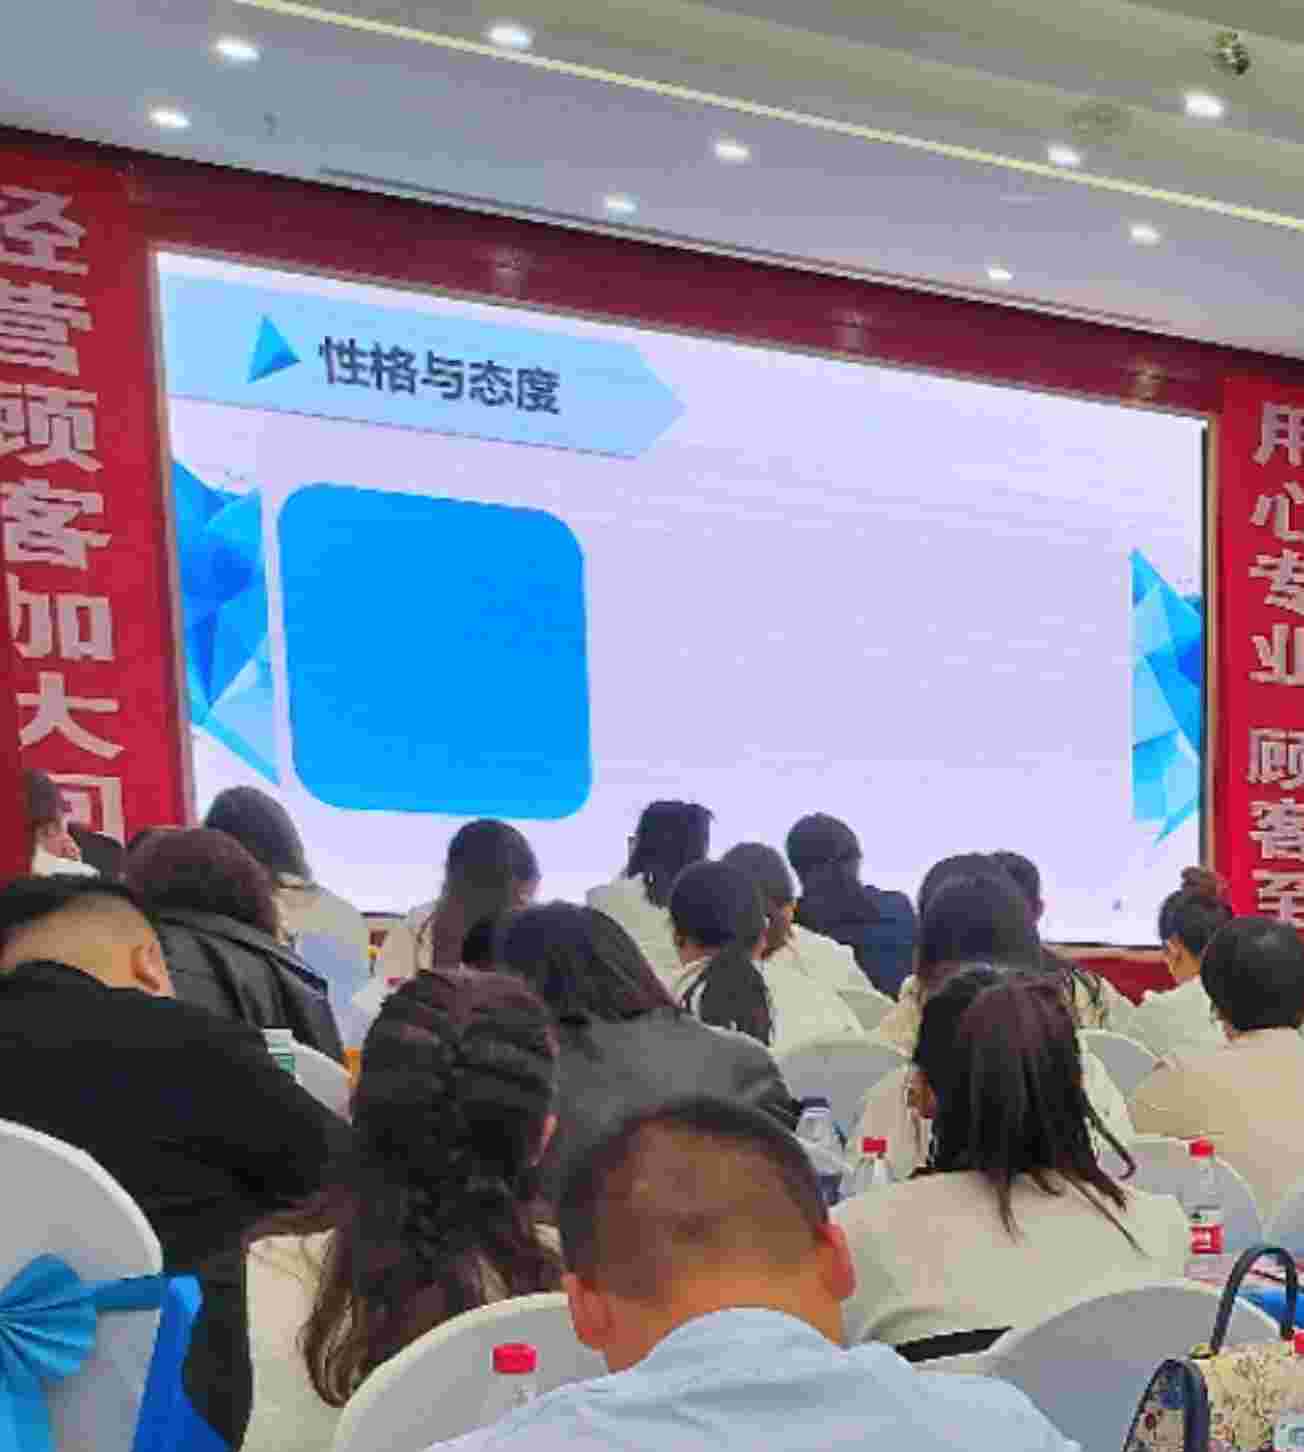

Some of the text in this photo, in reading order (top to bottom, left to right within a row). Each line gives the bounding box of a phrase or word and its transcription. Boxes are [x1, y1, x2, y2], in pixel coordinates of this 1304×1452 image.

[319, 335, 561, 416] 性格与态度
